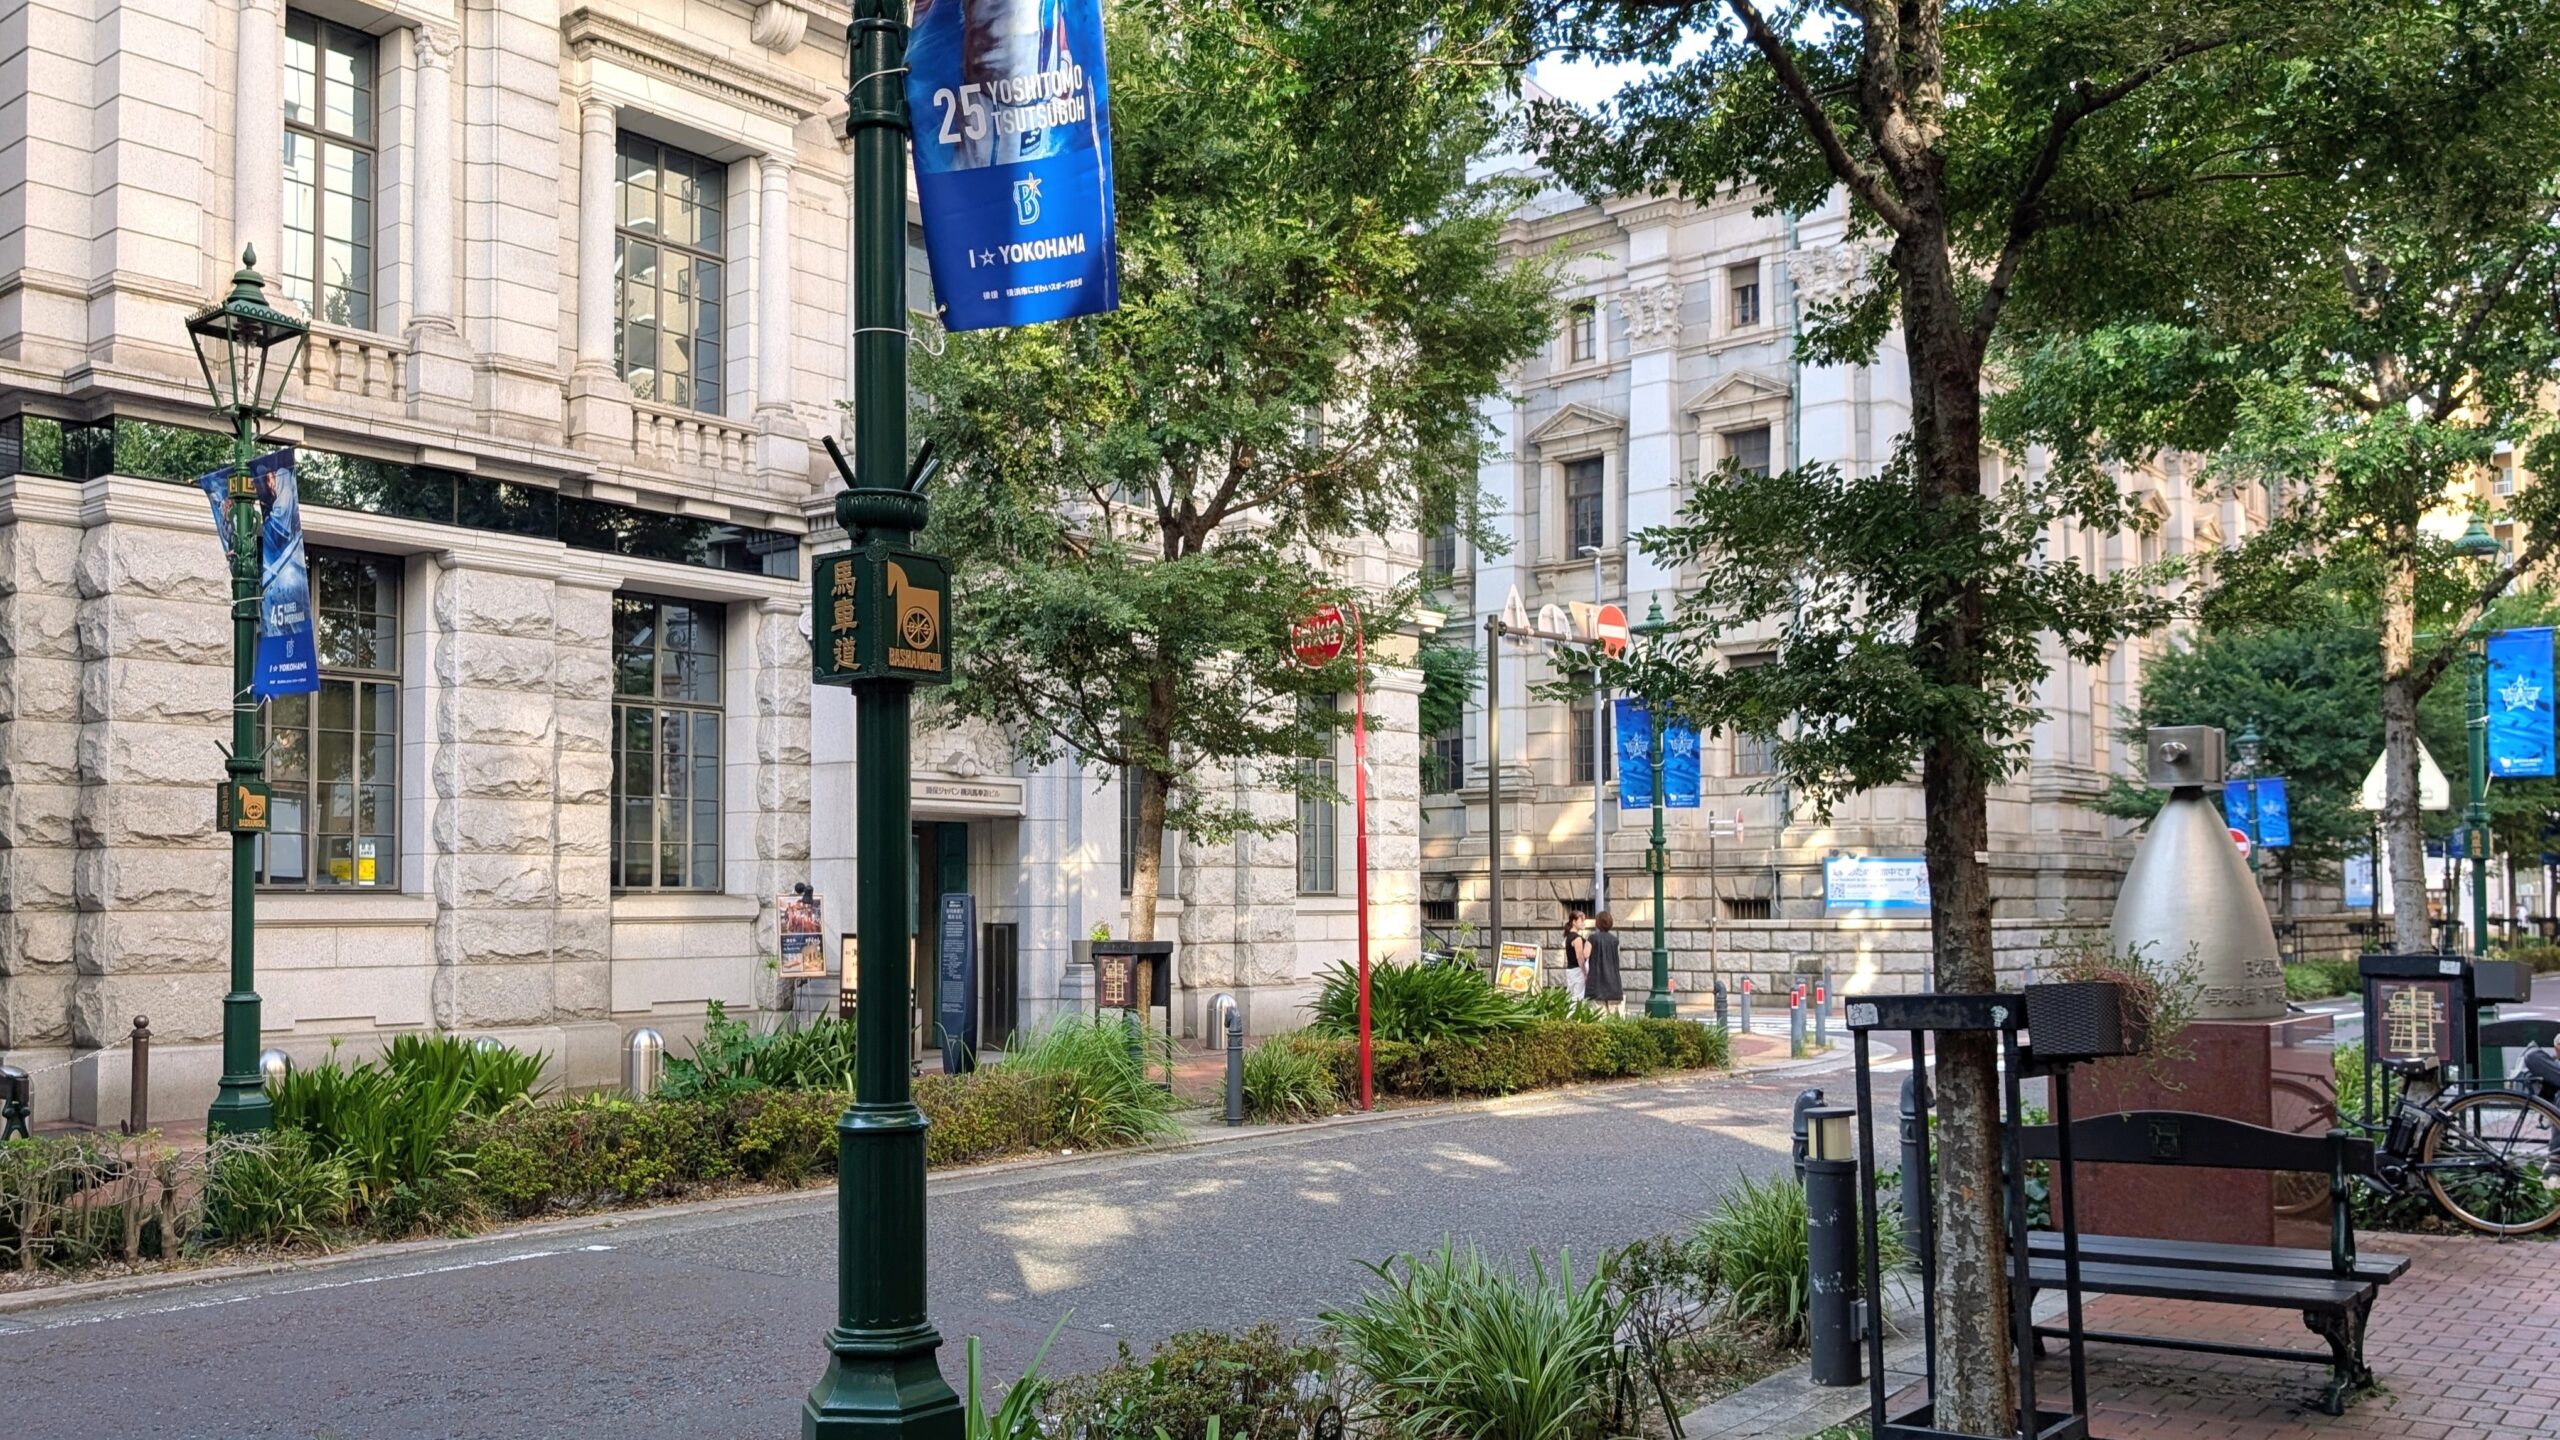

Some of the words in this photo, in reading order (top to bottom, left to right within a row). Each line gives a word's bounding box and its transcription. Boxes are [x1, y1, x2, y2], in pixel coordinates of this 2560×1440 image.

[933, 83, 987, 144] 25
[986, 65, 1083, 104] YOSHITOMO
[991, 95, 1085, 136] TSUTSUGOH
[969, 248, 976, 268] I
[998, 233, 1085, 264] YOKOHAMA
[270, 604, 283, 626] 45
[831, 560, 861, 672] 馬車道
[888, 647, 941, 672] BASHAMICHI
